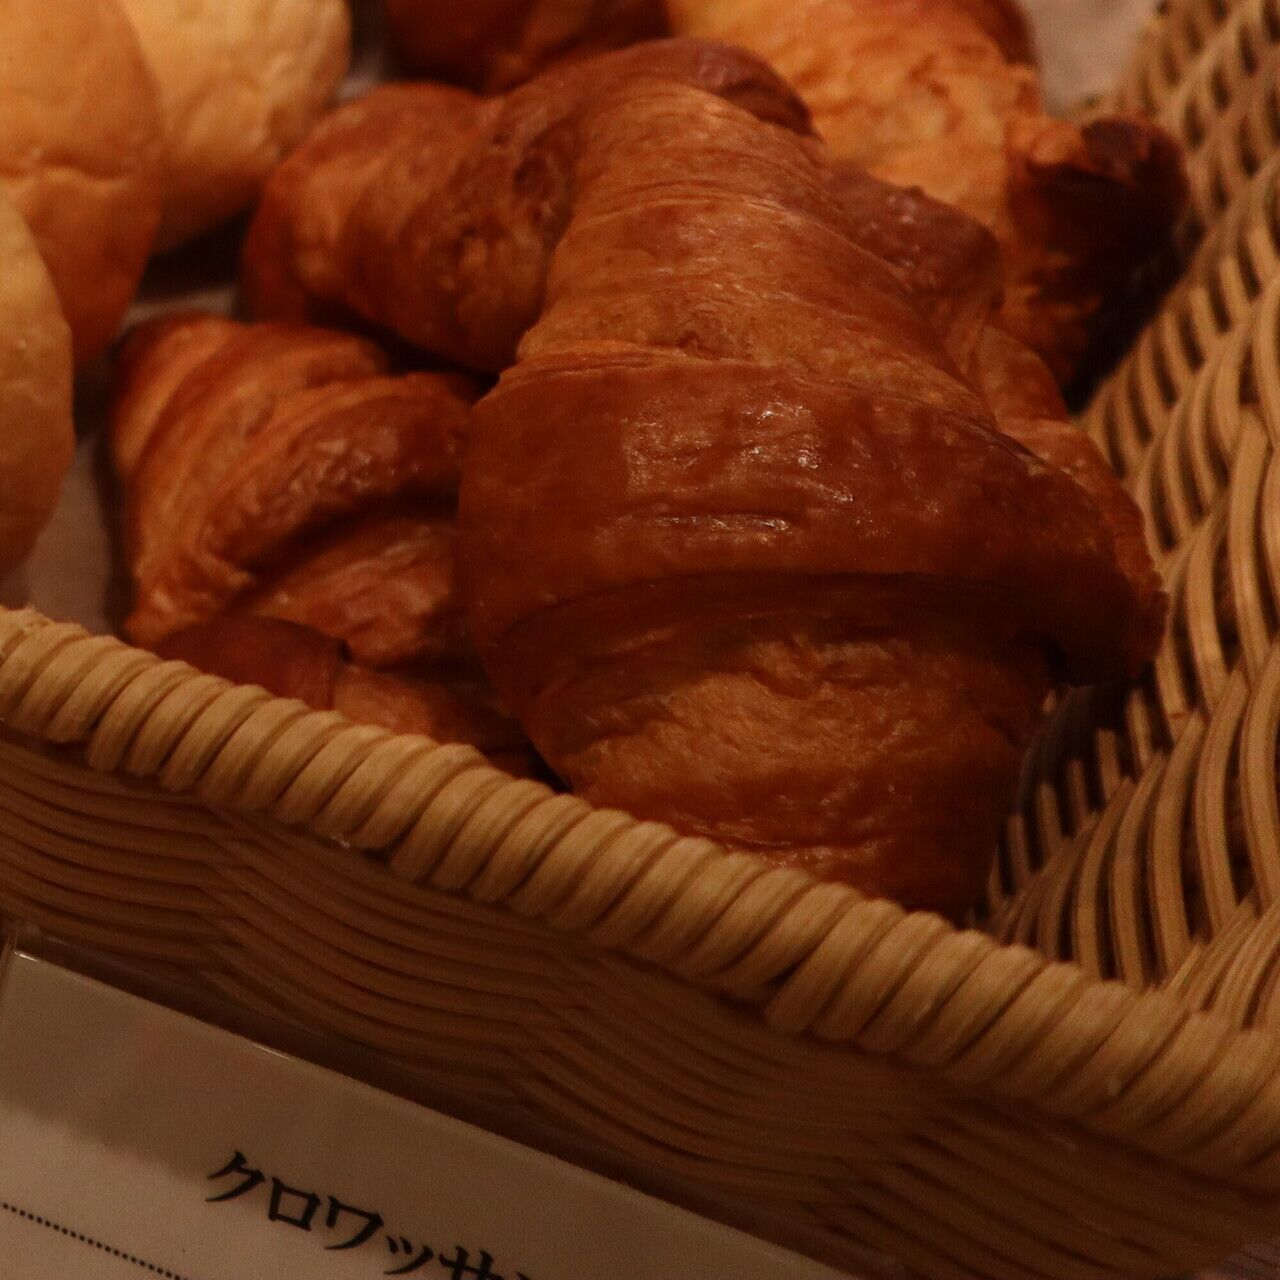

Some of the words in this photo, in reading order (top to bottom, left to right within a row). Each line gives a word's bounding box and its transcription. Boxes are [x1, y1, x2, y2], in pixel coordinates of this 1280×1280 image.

[204, 1150, 534, 1280] クロワッサ
